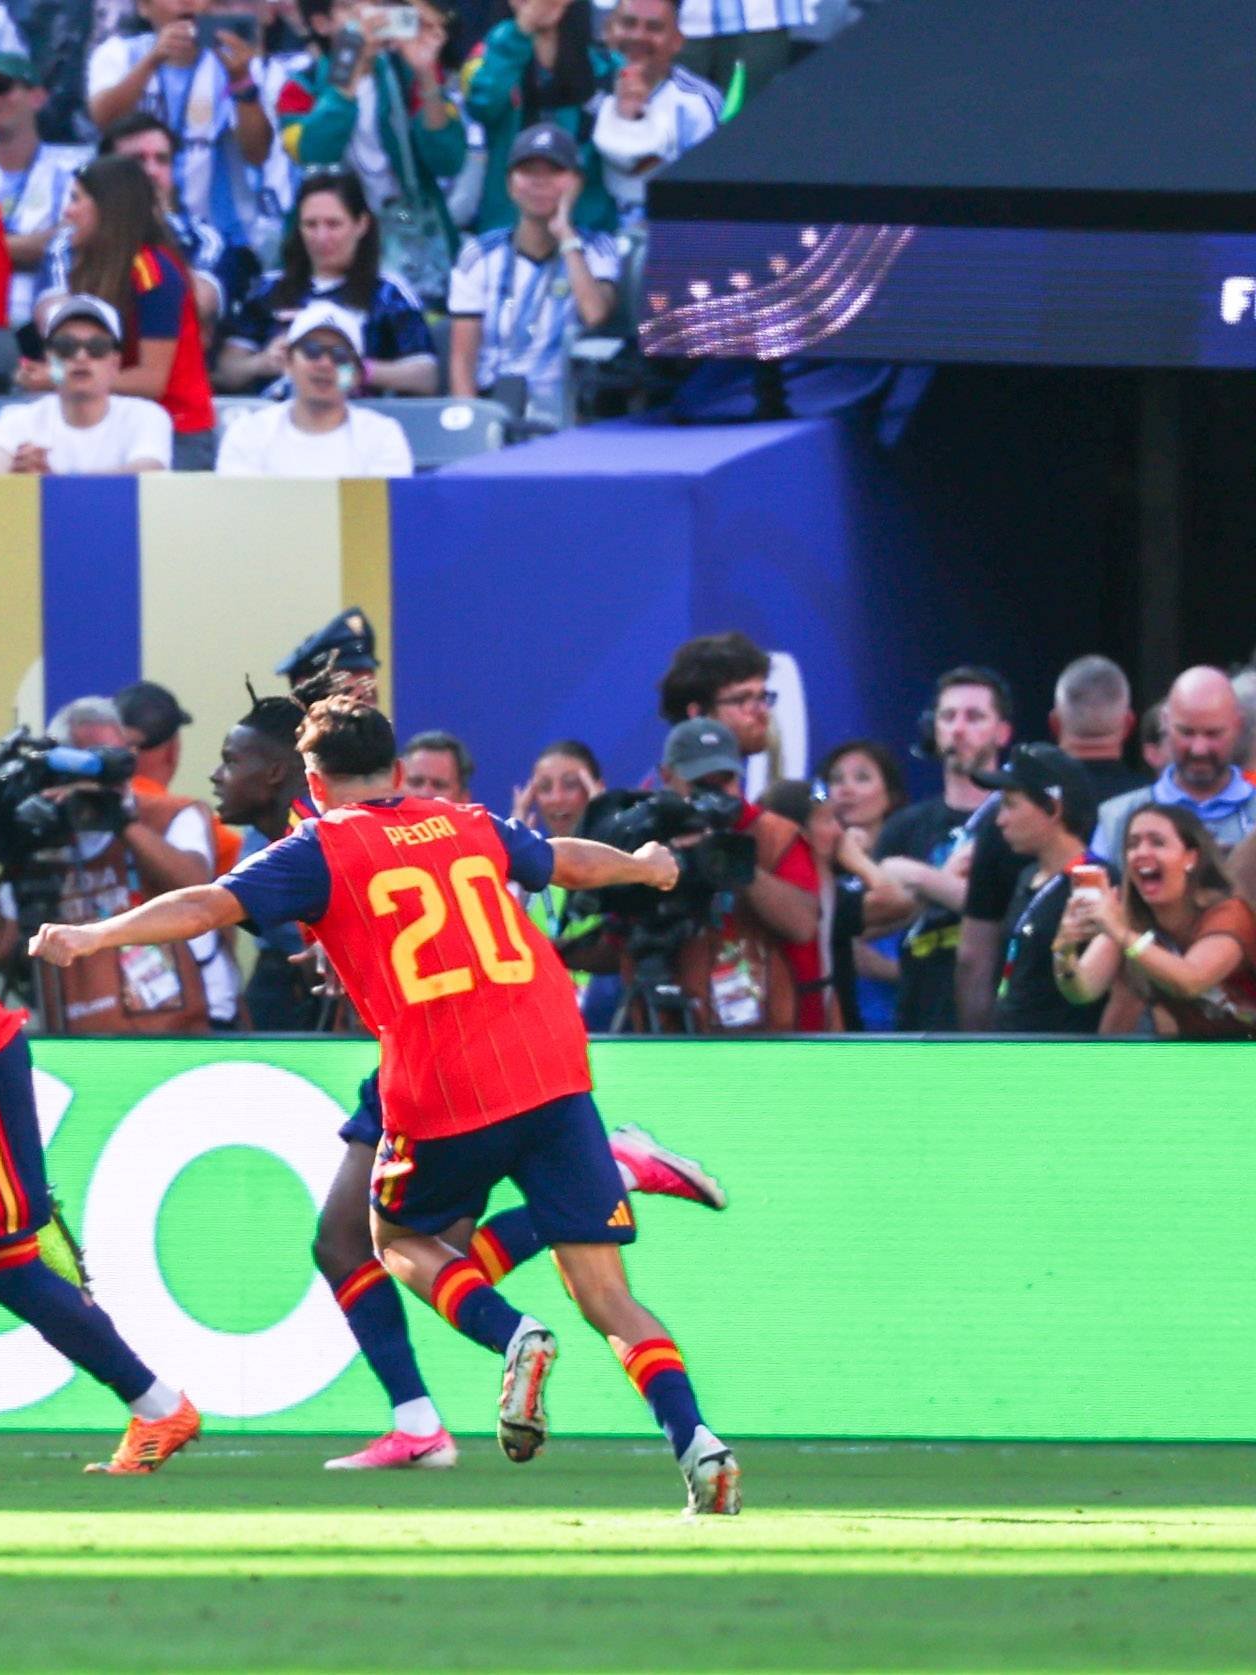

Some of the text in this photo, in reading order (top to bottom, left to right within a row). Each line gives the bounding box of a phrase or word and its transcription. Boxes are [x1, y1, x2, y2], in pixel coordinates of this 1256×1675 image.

[1221, 276, 1256, 324] F
[382, 815, 457, 846] PEDRI
[368, 855, 534, 1005] 20
